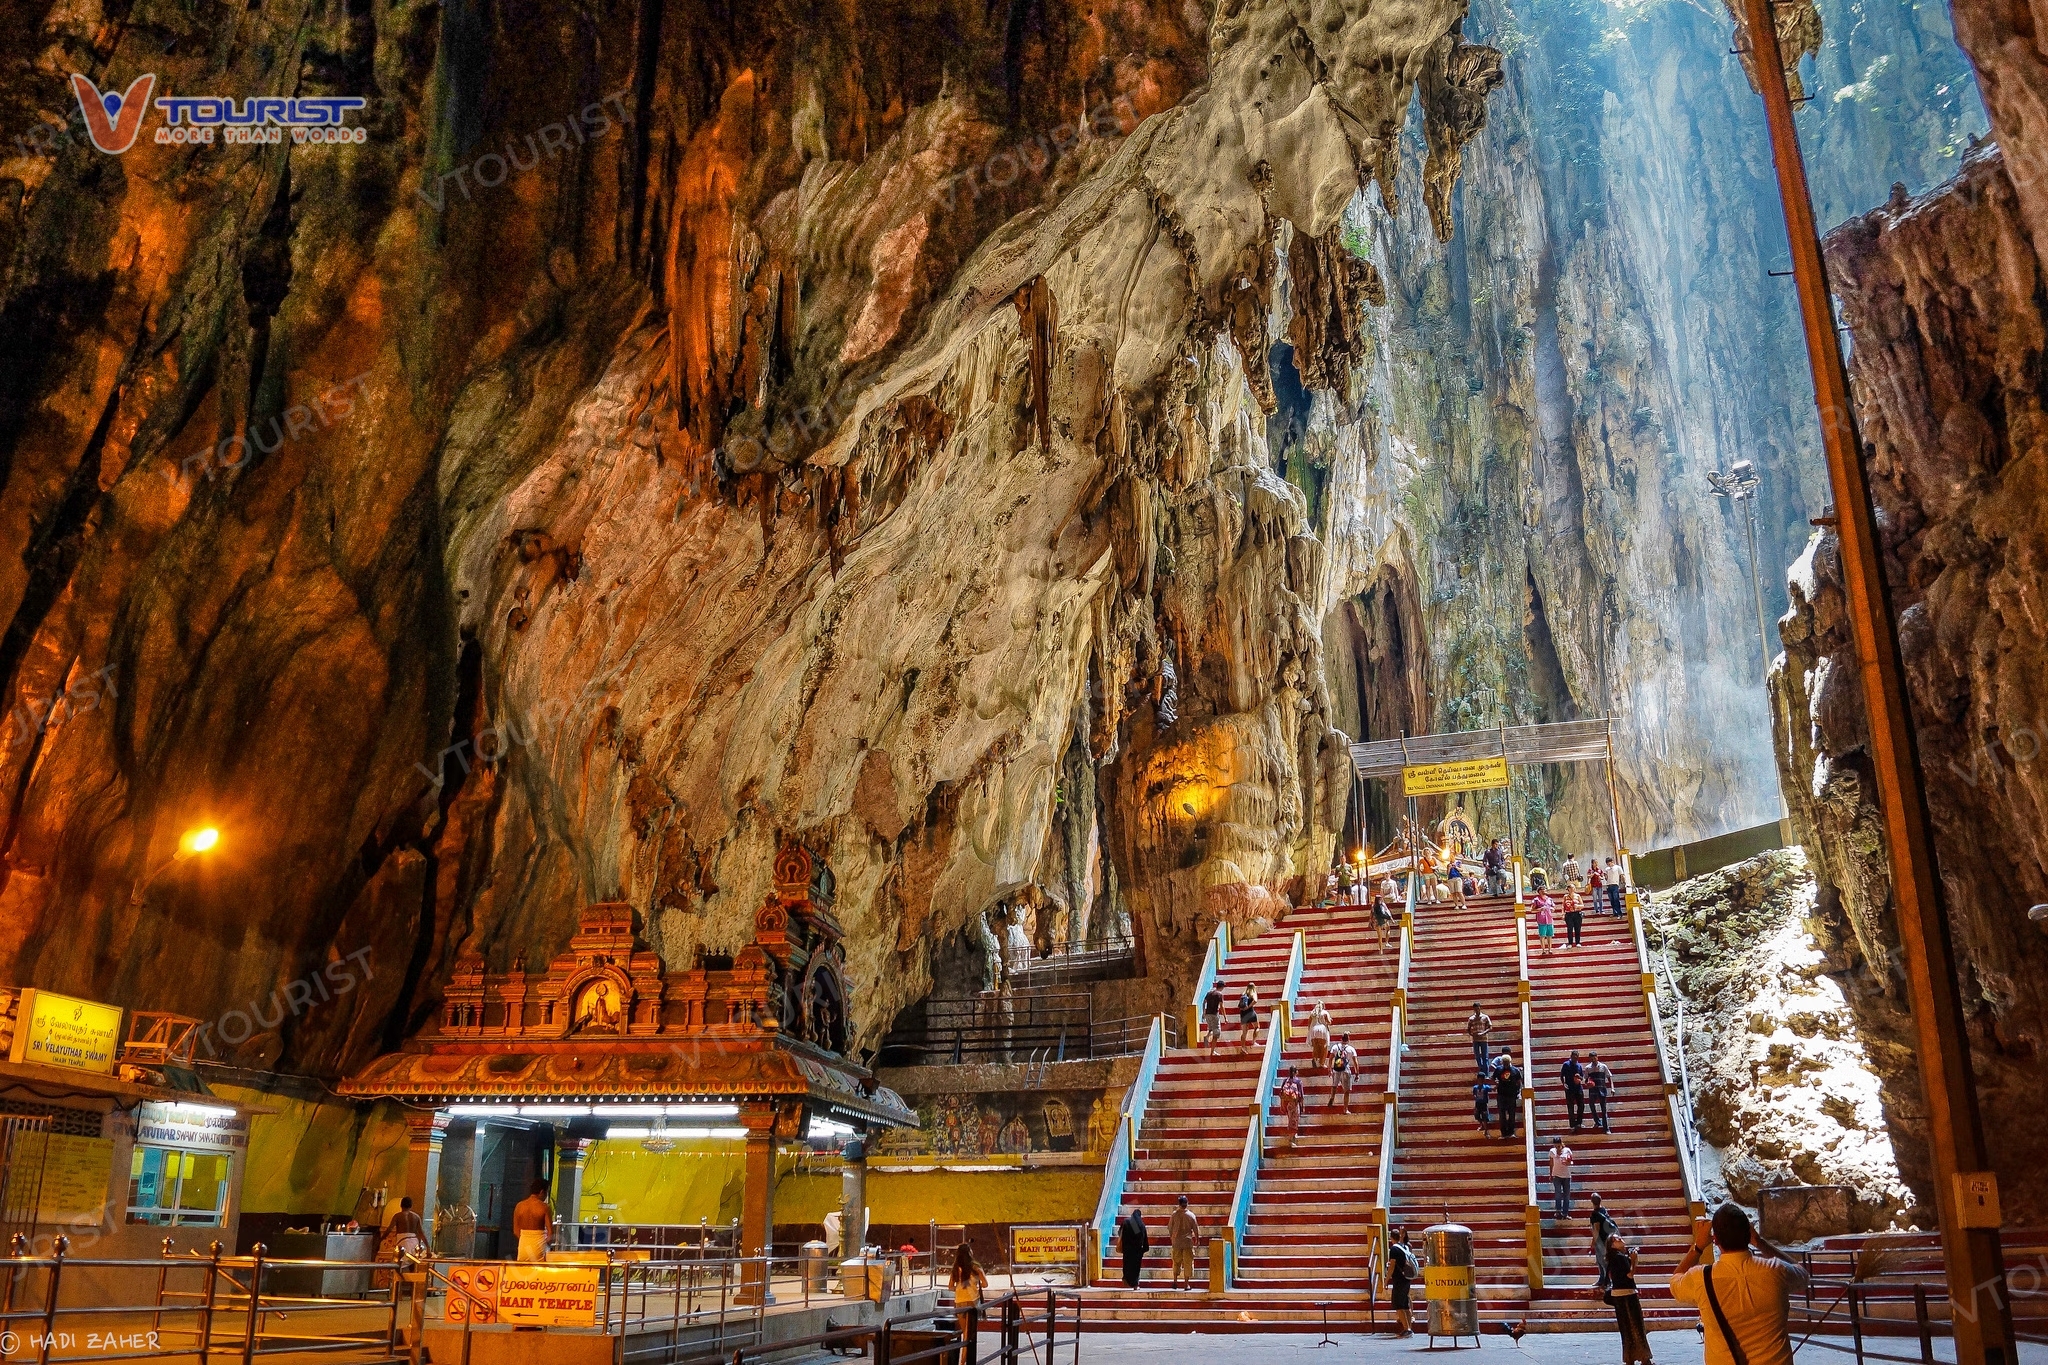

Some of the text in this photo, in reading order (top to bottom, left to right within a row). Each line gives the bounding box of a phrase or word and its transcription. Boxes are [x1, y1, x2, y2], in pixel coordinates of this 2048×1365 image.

[33, 1041, 107, 1062] SRI VELAYUTHAR SWAMY
[500, 1278, 595, 1294] மூலஸ்தானம்
[1435, 1279, 1467, 1287] UNDIAL
[500, 1297, 593, 1311] MAIN TEMPLE
